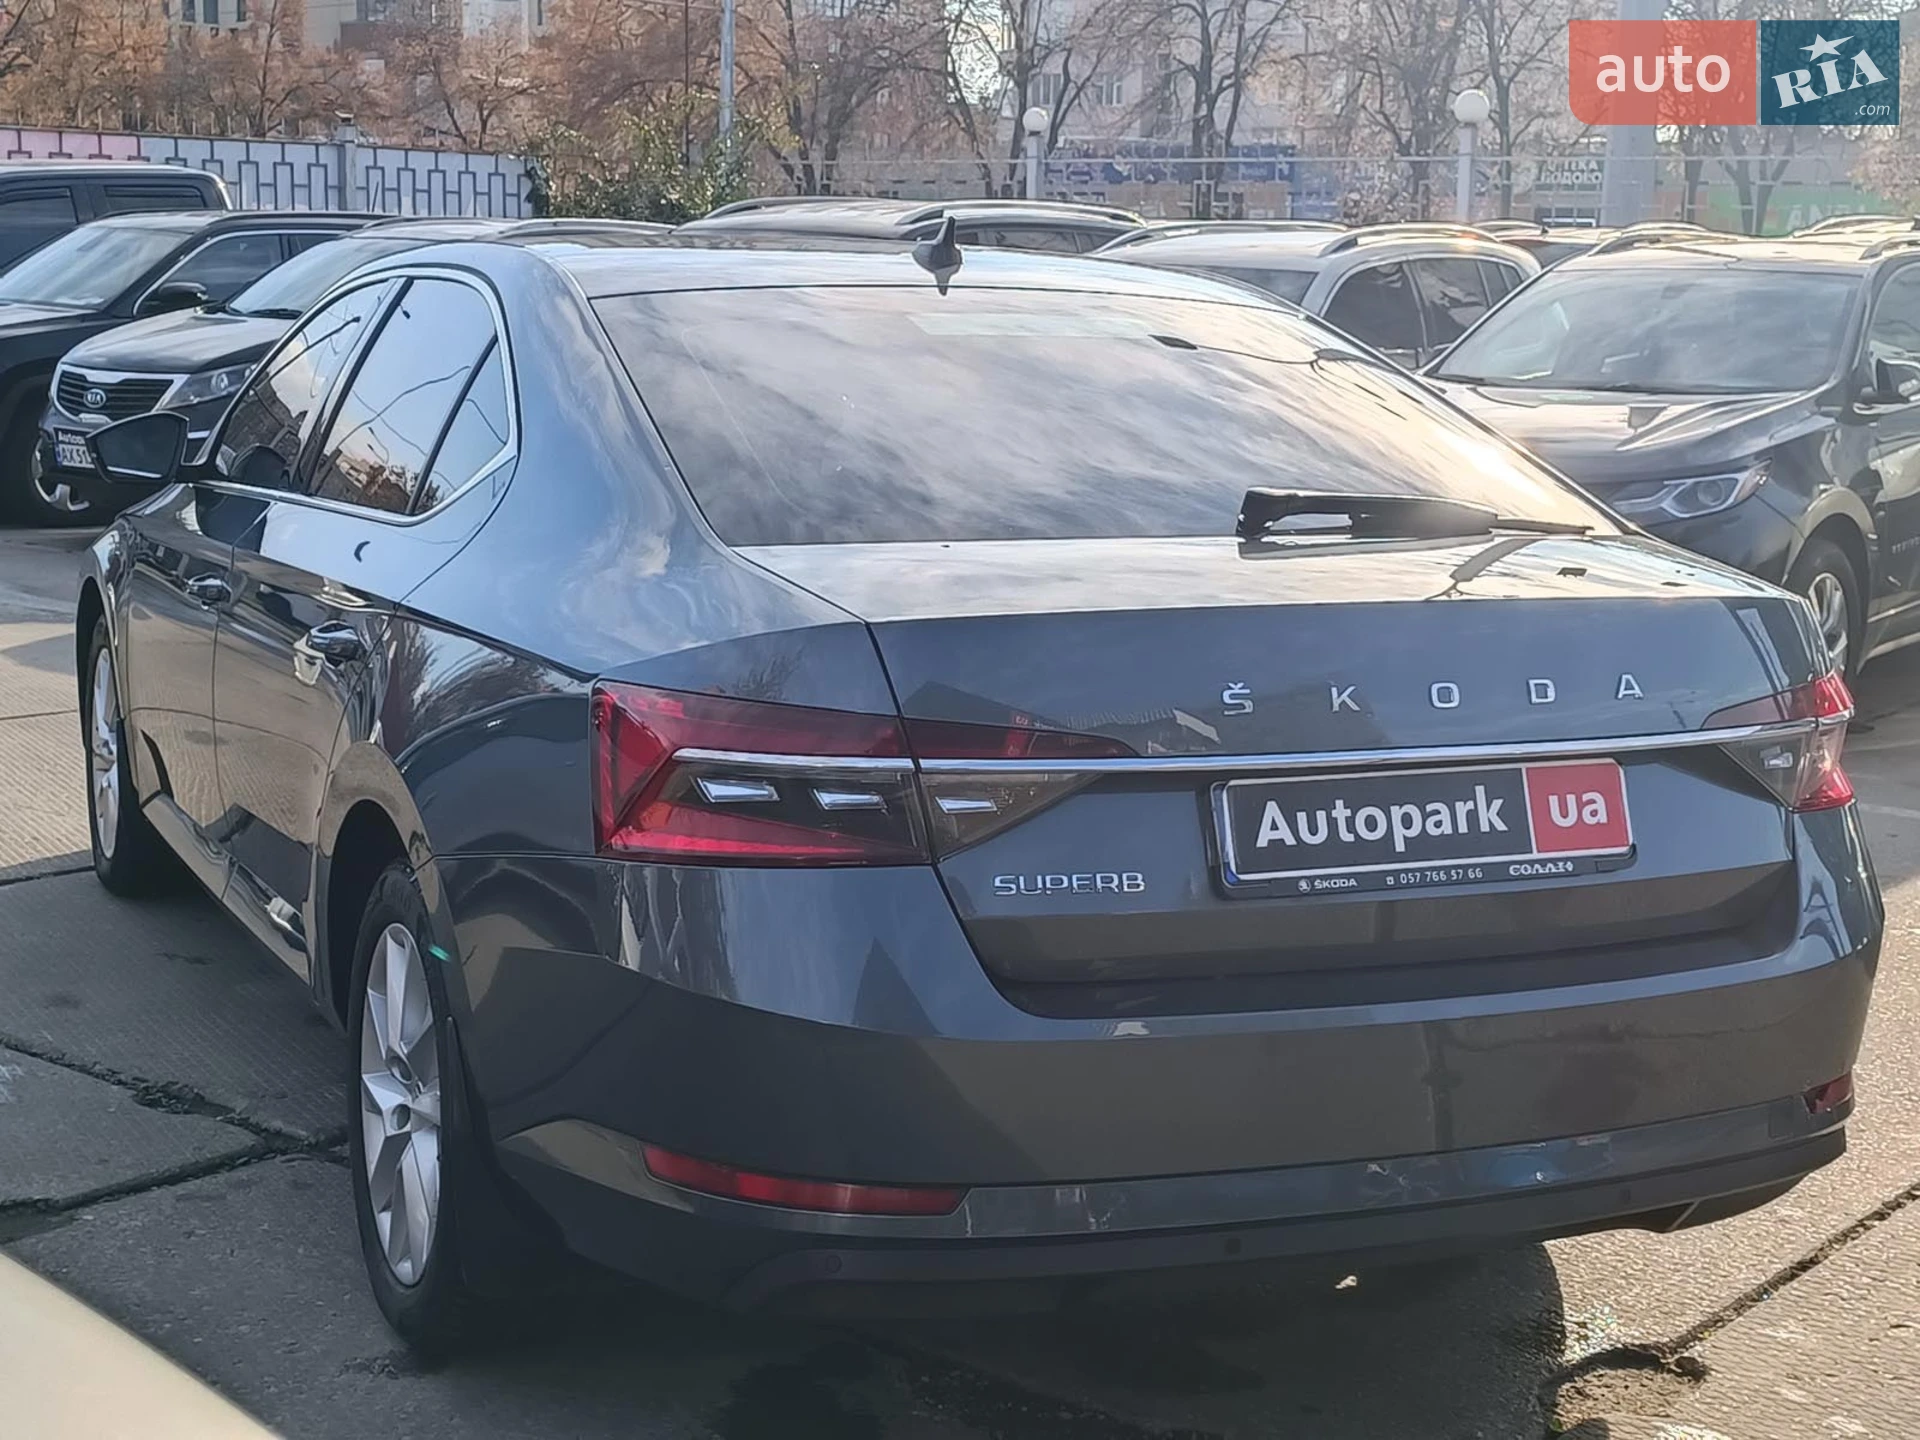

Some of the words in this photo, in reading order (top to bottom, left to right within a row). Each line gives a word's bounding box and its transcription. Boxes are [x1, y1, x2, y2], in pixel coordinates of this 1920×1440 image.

[1221, 673, 1645, 716] ŠKODA
[1255, 785, 1509, 853] Autopark
[1548, 790, 1609, 829] ua
[993, 872, 1146, 896] SUPERB
[1400, 872, 1421, 884] 057
[1425, 870, 1447, 883] 766
[1451, 869, 1463, 880] 57
[1468, 867, 1483, 879] 66
